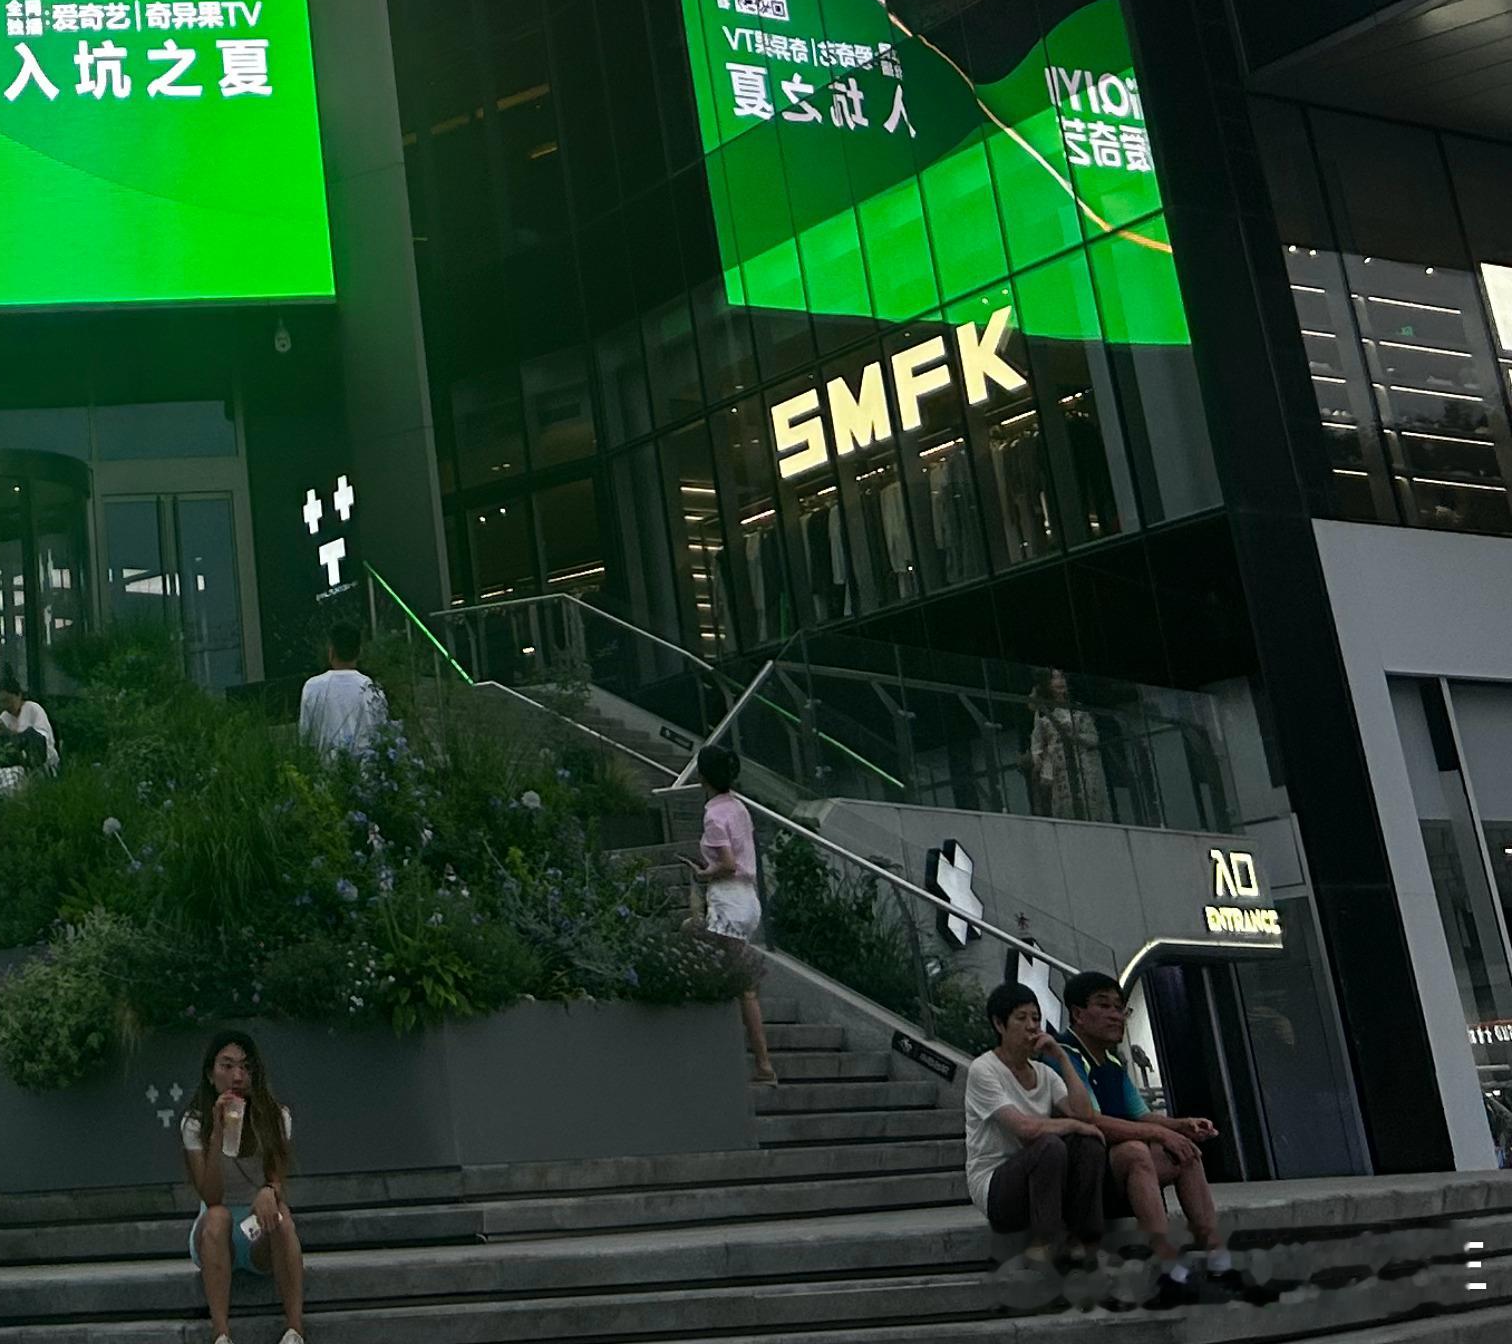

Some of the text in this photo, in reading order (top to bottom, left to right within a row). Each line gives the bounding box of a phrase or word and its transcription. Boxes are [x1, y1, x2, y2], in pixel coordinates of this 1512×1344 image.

[3, 38, 273, 102] 入坑之夏
[770, 305, 1028, 480] SMFK
[1210, 849, 1259, 897] 入口
[1204, 906, 1281, 934] ENTRANCE
